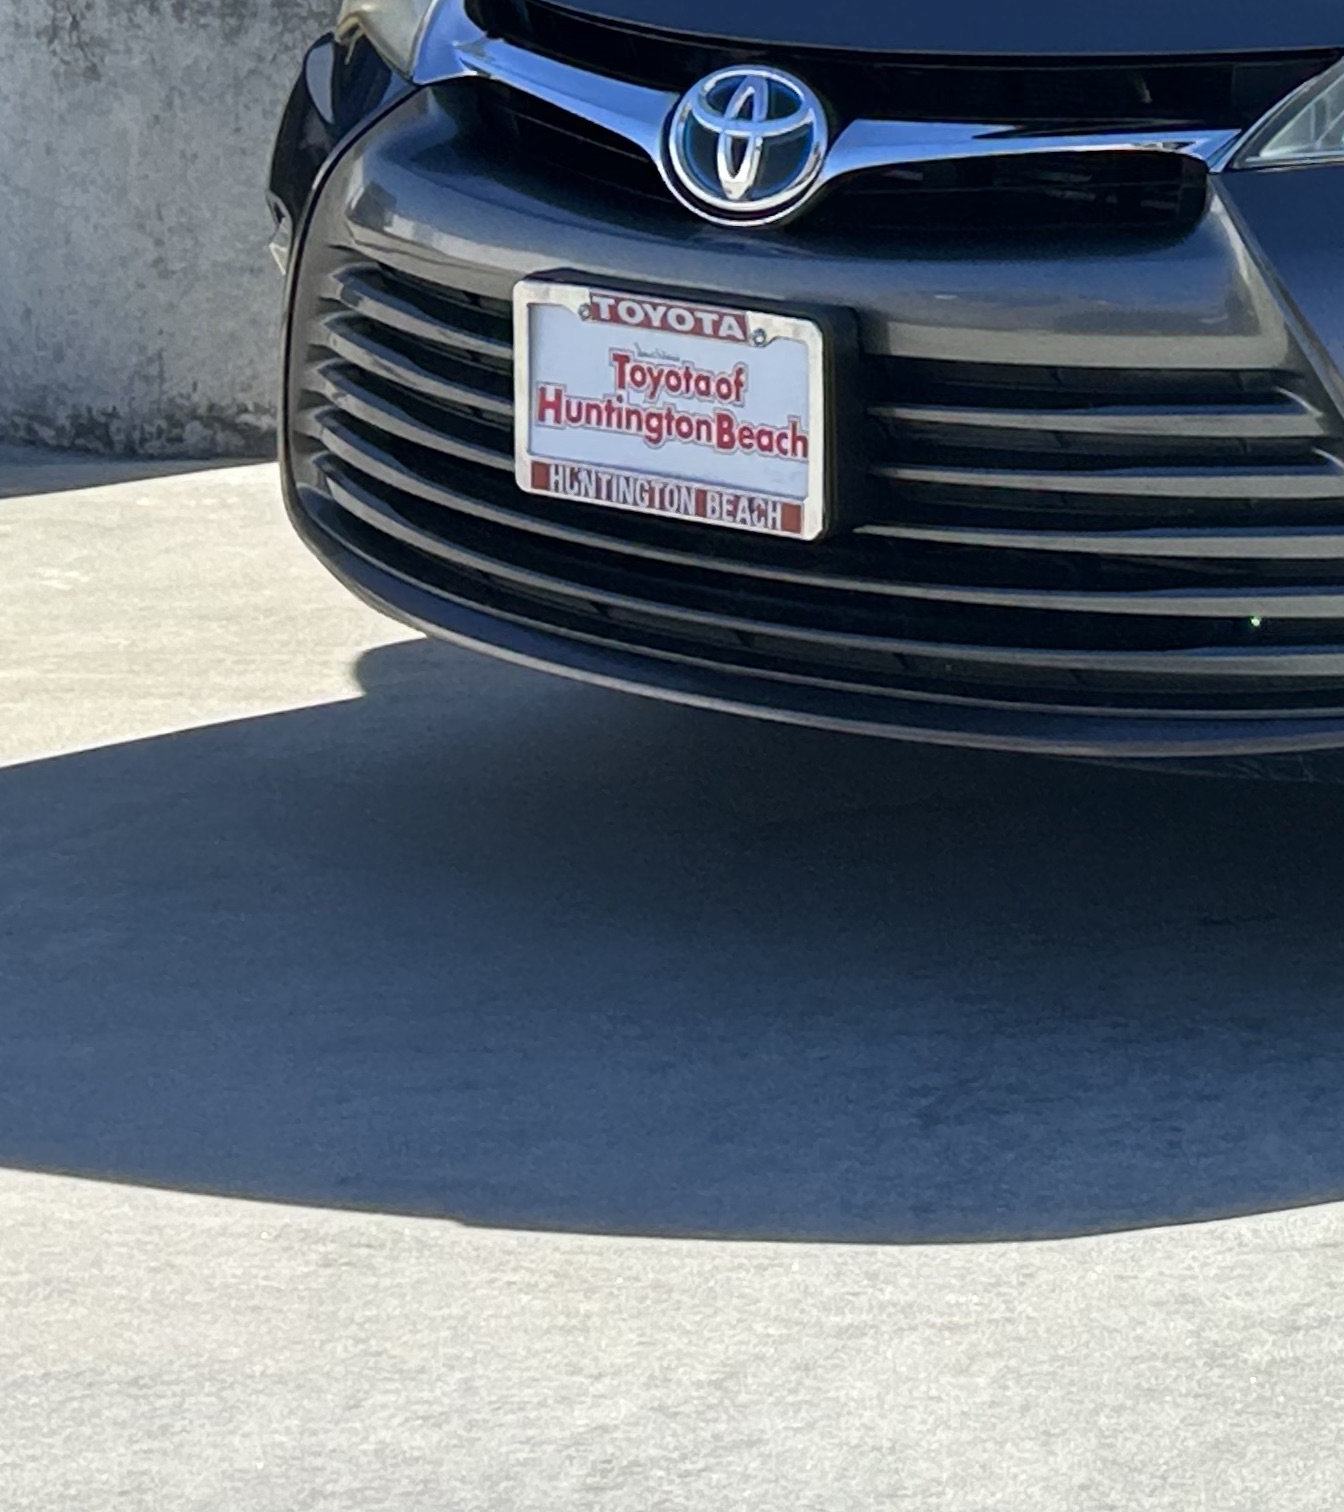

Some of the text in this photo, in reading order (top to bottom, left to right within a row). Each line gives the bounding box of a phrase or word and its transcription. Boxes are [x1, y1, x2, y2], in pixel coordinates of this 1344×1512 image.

[591, 295, 746, 340] TOYOTA
[611, 351, 712, 401] Toyota
[537, 385, 809, 459] Huntington Beach
[550, 463, 783, 531] HUNTINGTON BEACH
